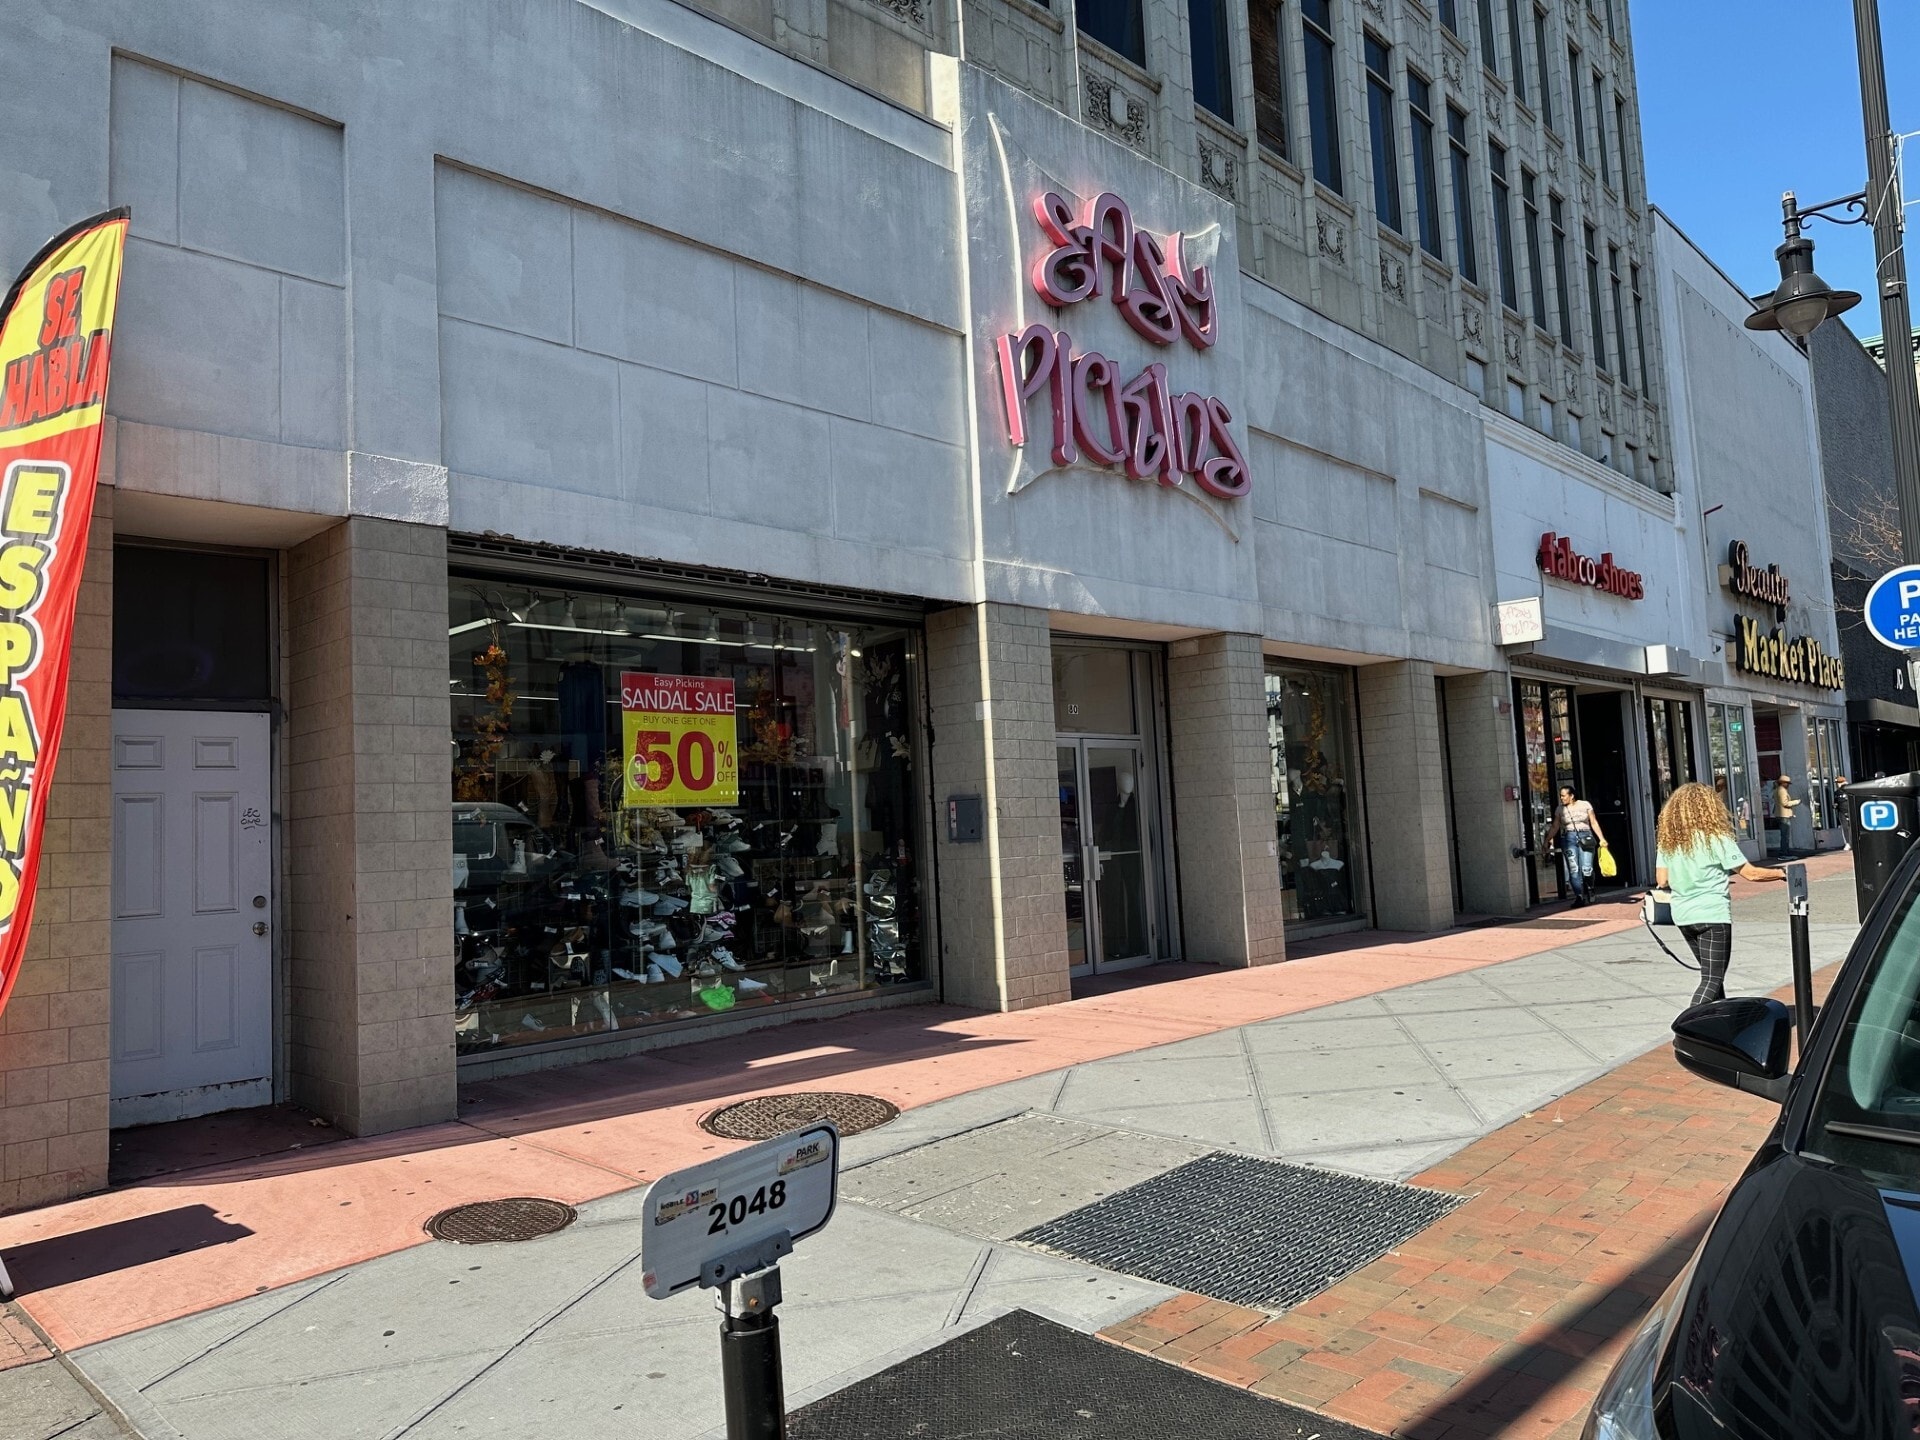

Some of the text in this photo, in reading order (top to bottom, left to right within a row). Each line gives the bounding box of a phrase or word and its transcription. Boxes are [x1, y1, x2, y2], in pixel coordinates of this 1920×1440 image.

[40, 270, 84, 347] SE
[0, 335, 109, 428] HABLA
[1541, 532, 1644, 599] fabco shoes
[1730, 540, 1790, 606] Beauty
[1900, 613, 1920, 626] PA
[1894, 626, 1920, 640] HE
[1737, 615, 1805, 683] Market
[1806, 636, 1844, 690] Place
[654, 677, 705, 689] Easy Pickins
[0, 470, 59, 928] ESPAÑO
[622, 687, 734, 713] SANDAL SALE
[643, 715, 716, 726] BUY ONE GET ONE
[717, 771, 737, 783] OFF
[1870, 806, 1889, 826] P
[796, 1142, 819, 1158] PARK
[708, 1179, 787, 1236] 2048
